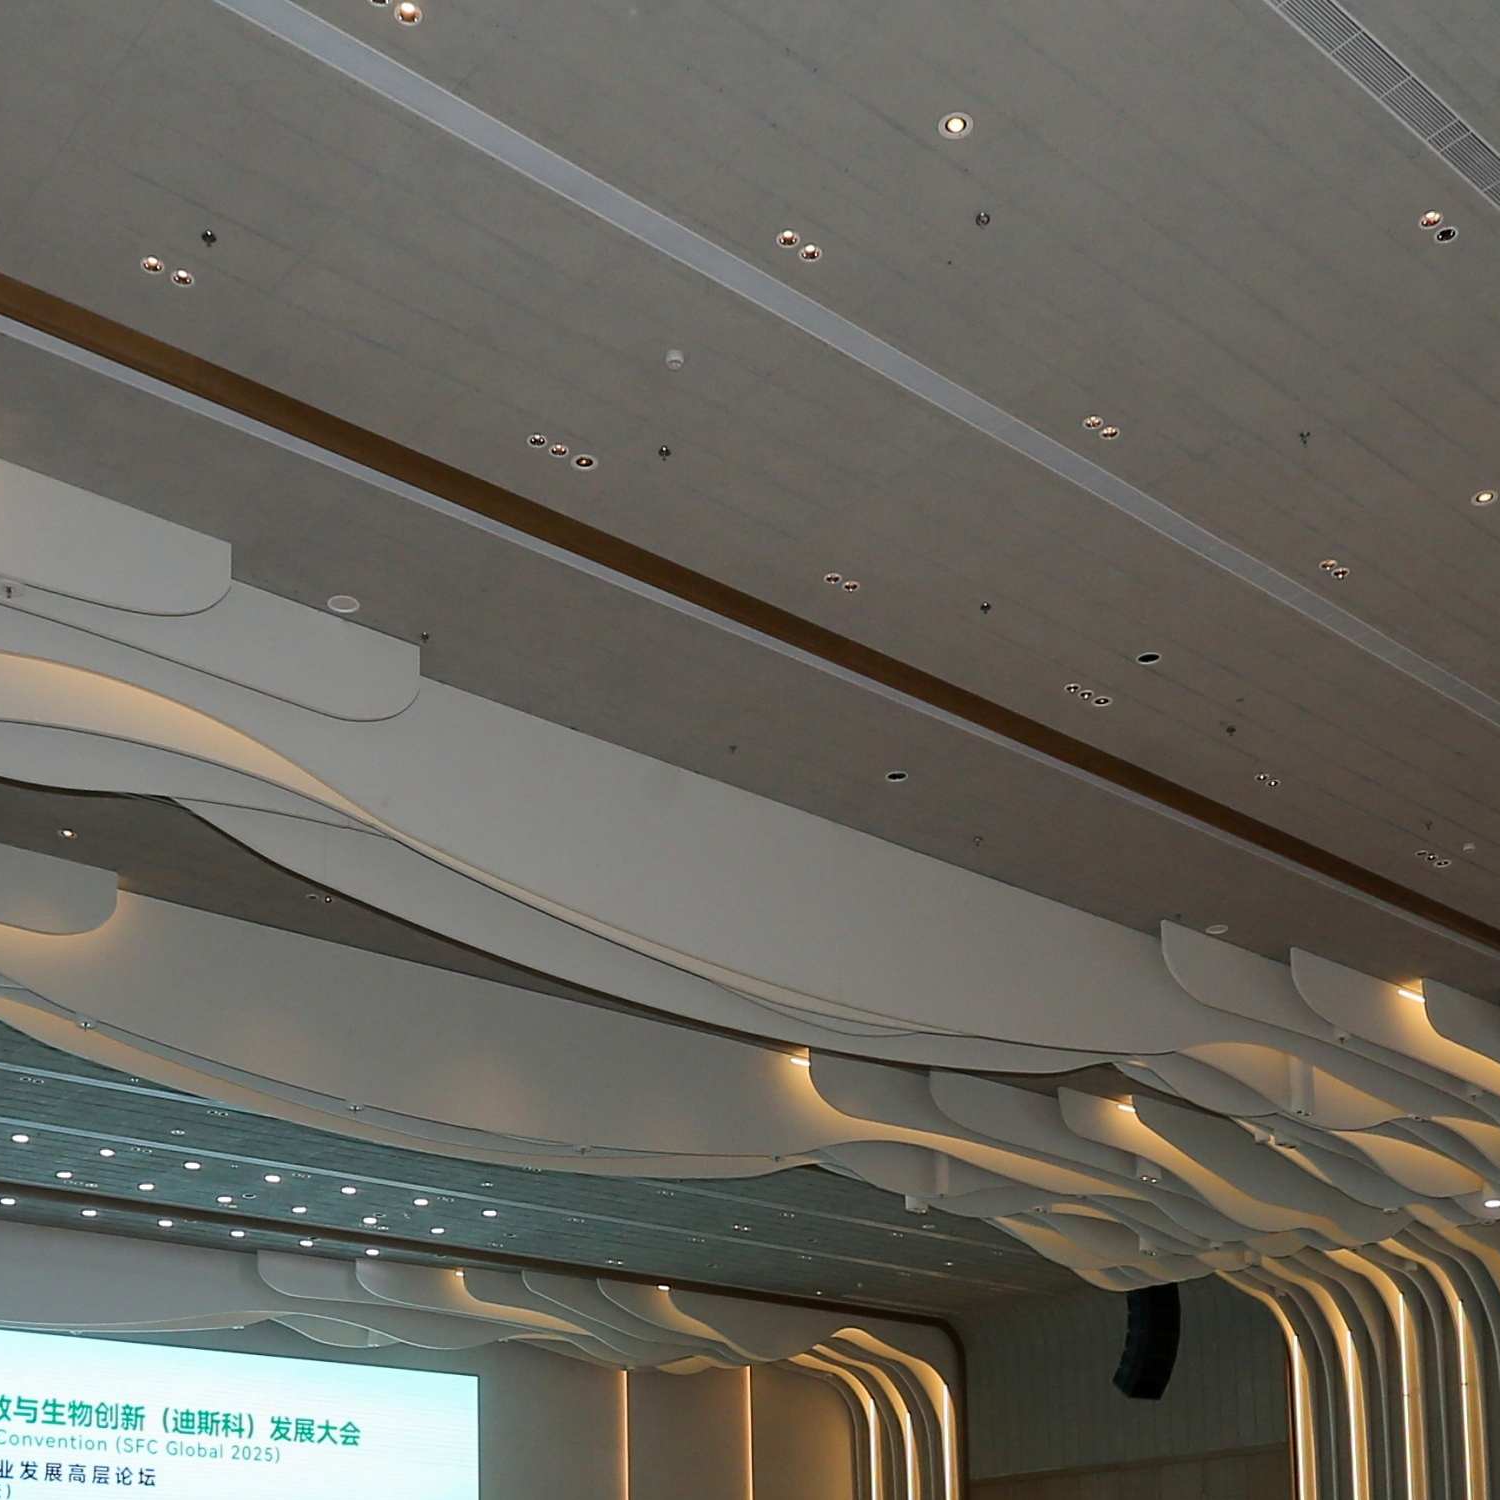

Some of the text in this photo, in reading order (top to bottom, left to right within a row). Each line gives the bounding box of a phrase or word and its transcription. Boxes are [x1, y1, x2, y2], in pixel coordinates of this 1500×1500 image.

[116, 1435, 159, 1456] (SFC
[166, 1440, 223, 1459] Global
[231, 1444, 281, 1465] 2025)
